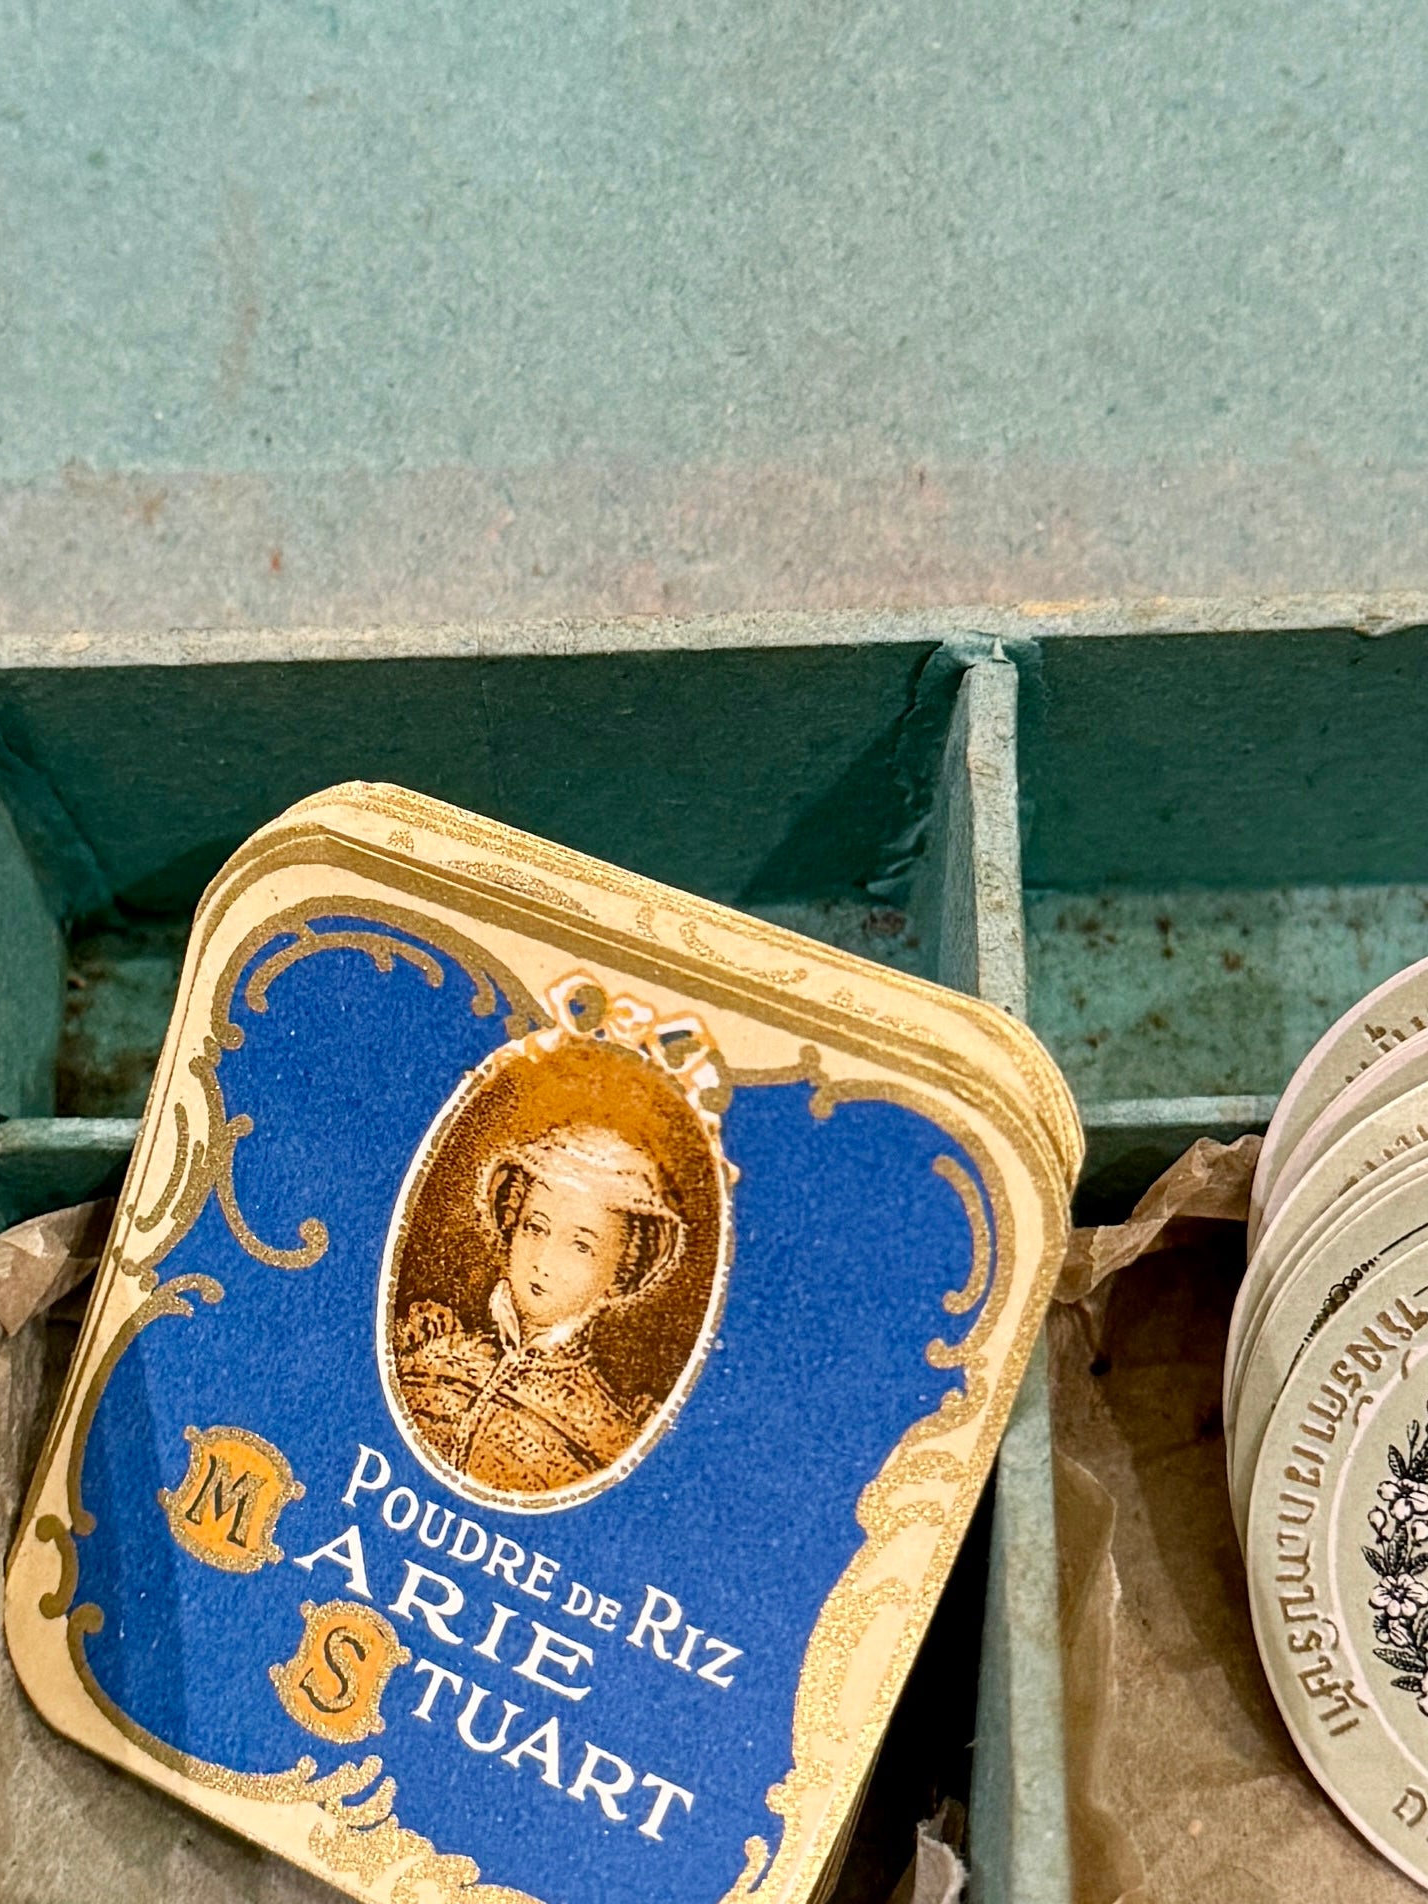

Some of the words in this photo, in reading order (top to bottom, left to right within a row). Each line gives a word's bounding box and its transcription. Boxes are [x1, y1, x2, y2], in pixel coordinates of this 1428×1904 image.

[342, 1442, 561, 1606] POUDRE
[562, 1580, 623, 1632] DE
[624, 1584, 745, 1689] RIZ
[298, 1625, 695, 1842] STUART
